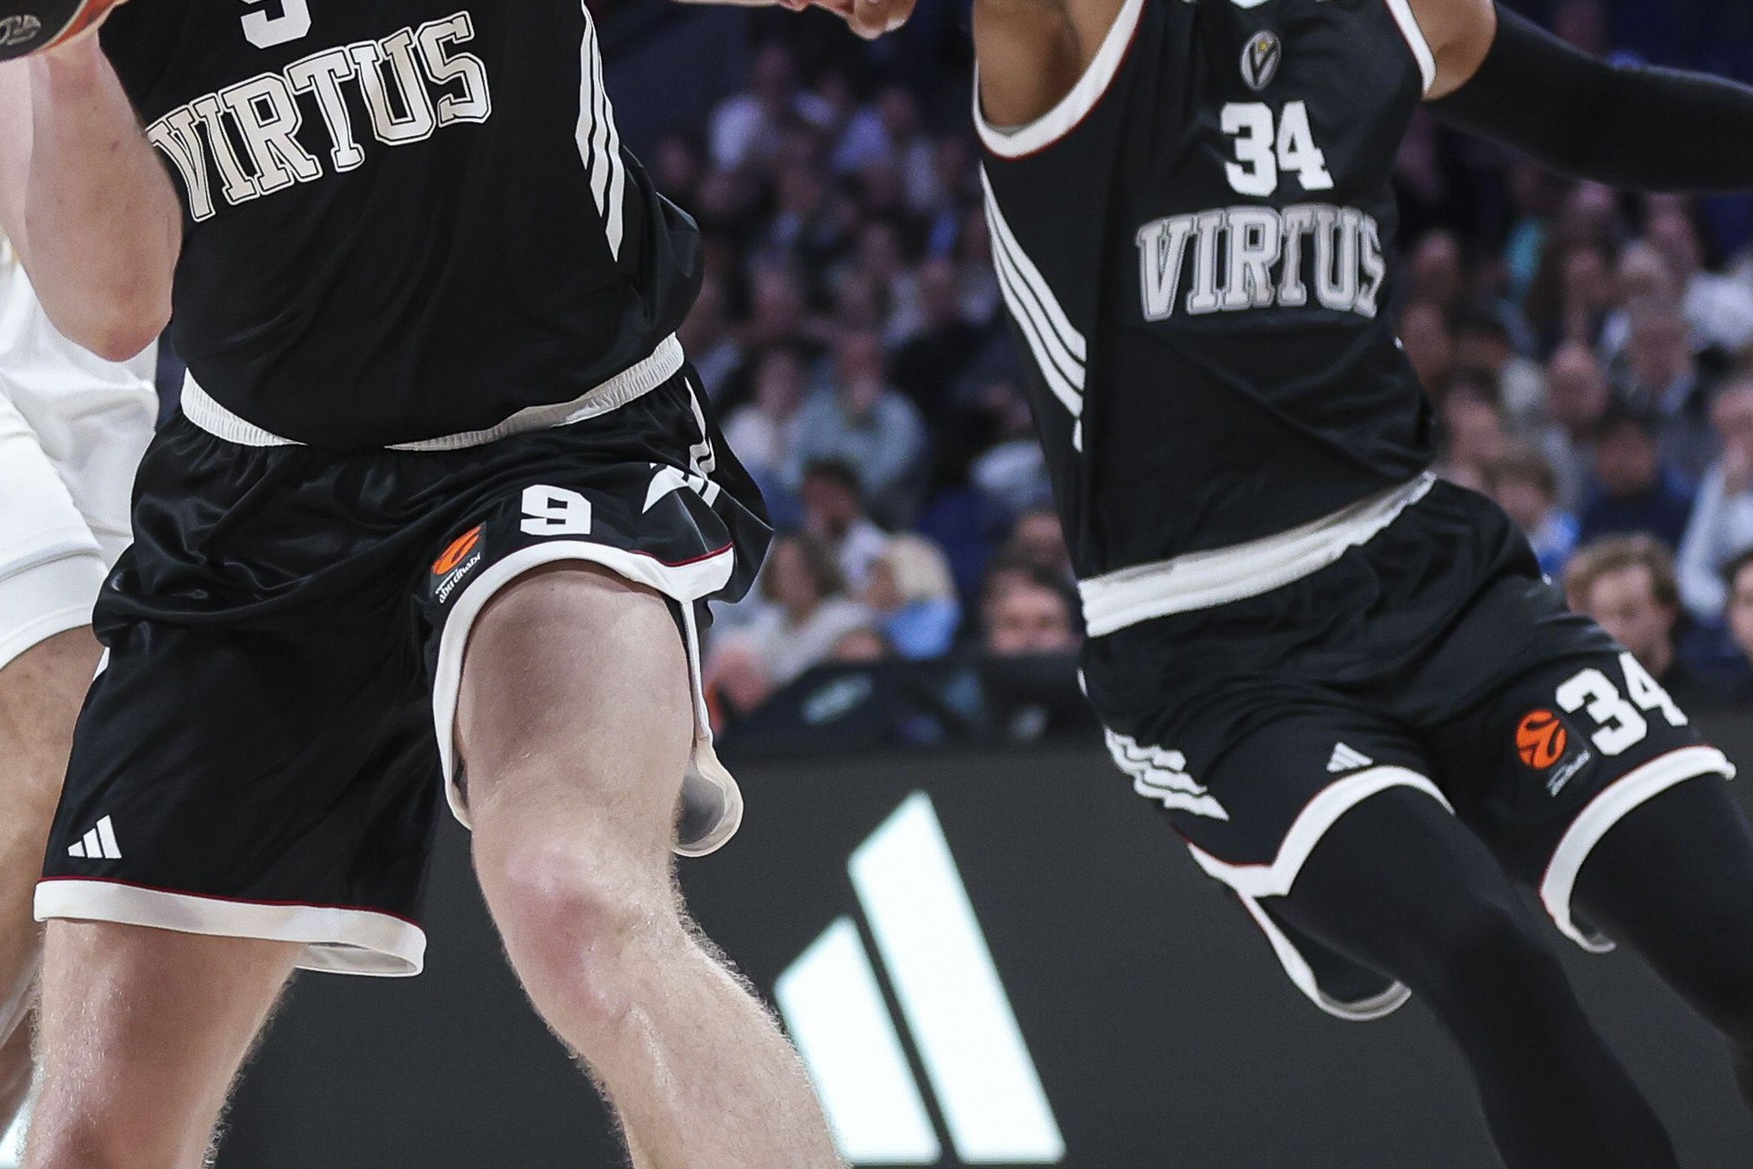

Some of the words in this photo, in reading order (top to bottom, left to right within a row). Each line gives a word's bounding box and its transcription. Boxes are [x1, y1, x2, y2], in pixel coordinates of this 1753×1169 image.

[146, 10, 491, 221] VIRTUS
[1220, 100, 1334, 197] 34
[1135, 204, 1385, 322] VIRTUS
[520, 484, 592, 536] 9
[1556, 651, 1688, 756] 34
